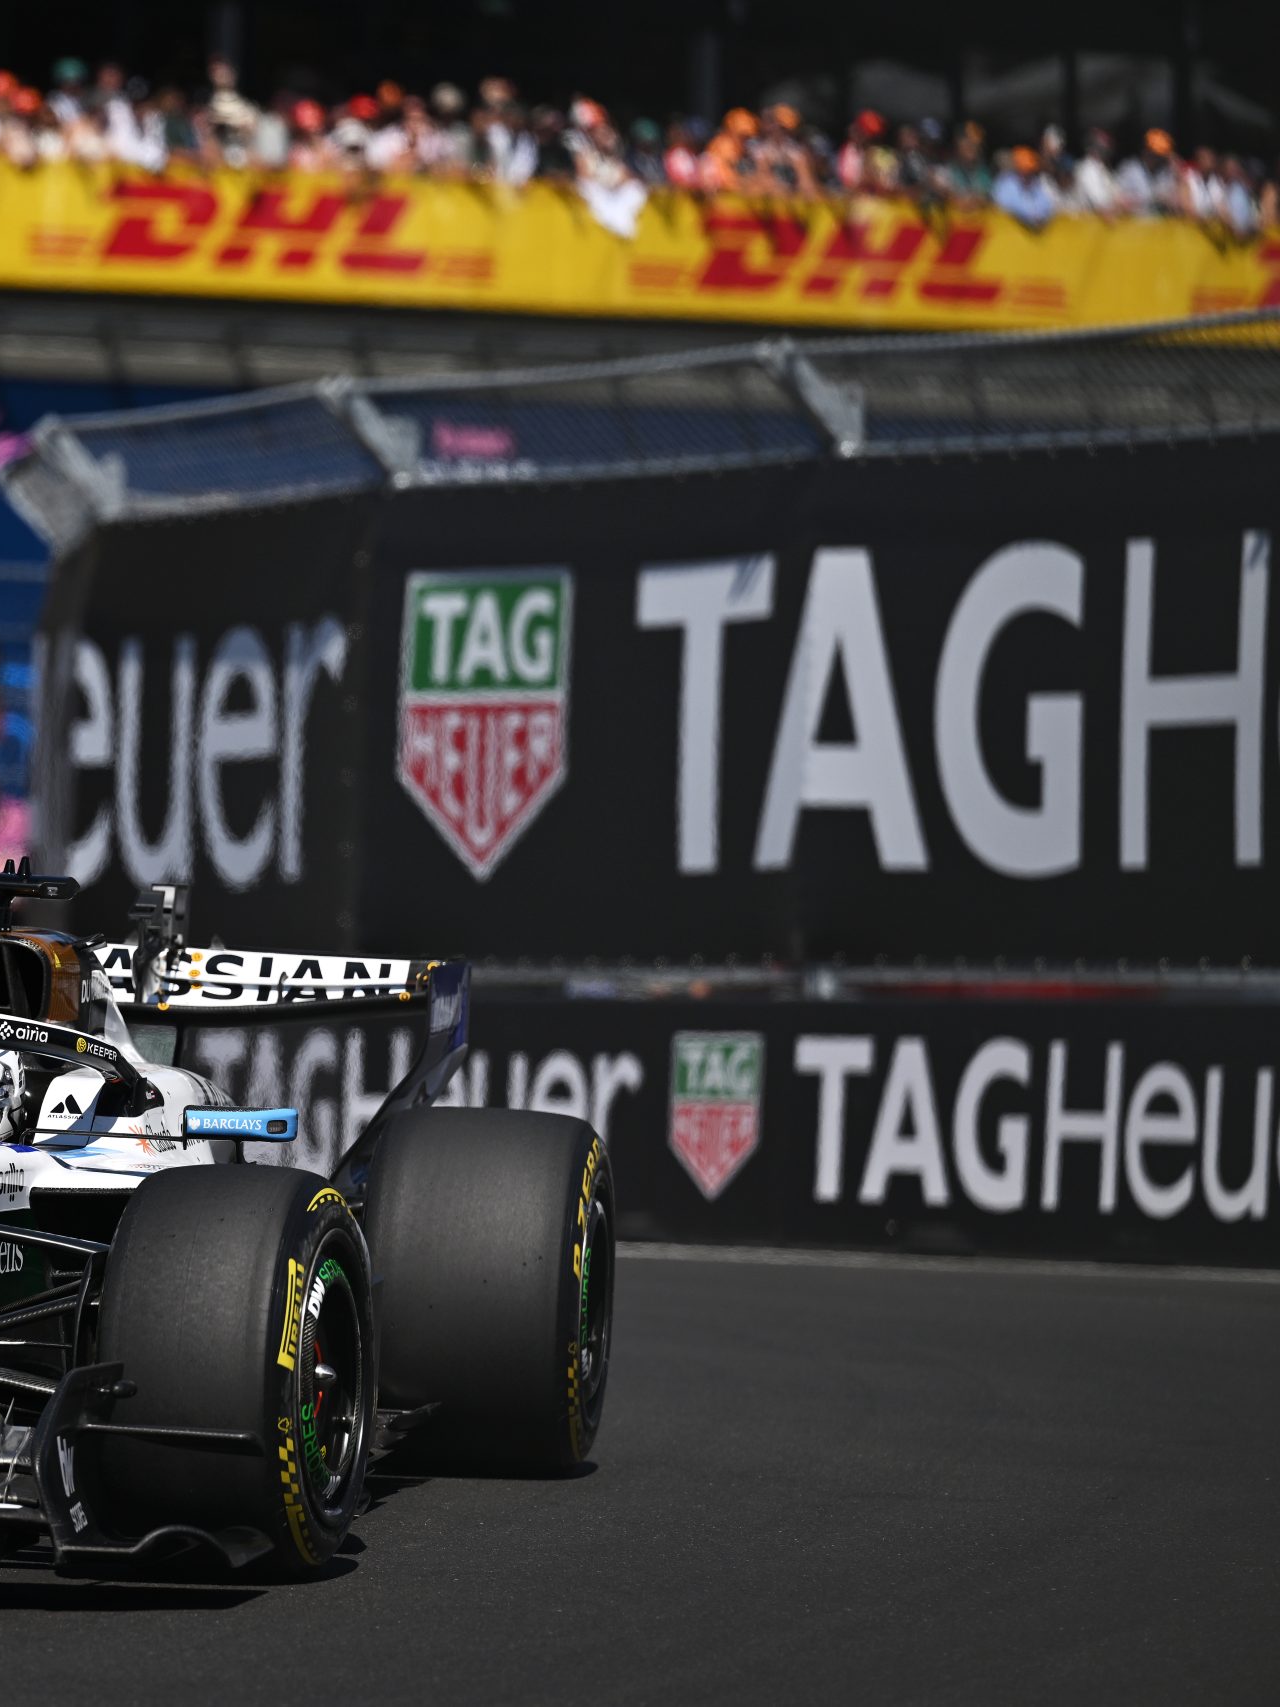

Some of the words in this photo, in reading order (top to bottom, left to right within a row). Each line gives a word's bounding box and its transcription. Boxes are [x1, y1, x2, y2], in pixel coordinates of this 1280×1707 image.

[101, 182, 429, 275] DHL
[699, 212, 1001, 305] DHL
[421, 588, 555, 684] TAG
[636, 529, 1280, 879] TAGH
[406, 706, 560, 846] HEUER
[15, 1025, 49, 1043] airia
[86, 1042, 118, 1061] KEEPER
[203, 1117, 262, 1131] BARCLAYS
[794, 1034, 1280, 1222] TAGHeu
[276, 1258, 305, 1371] PIRELLI
